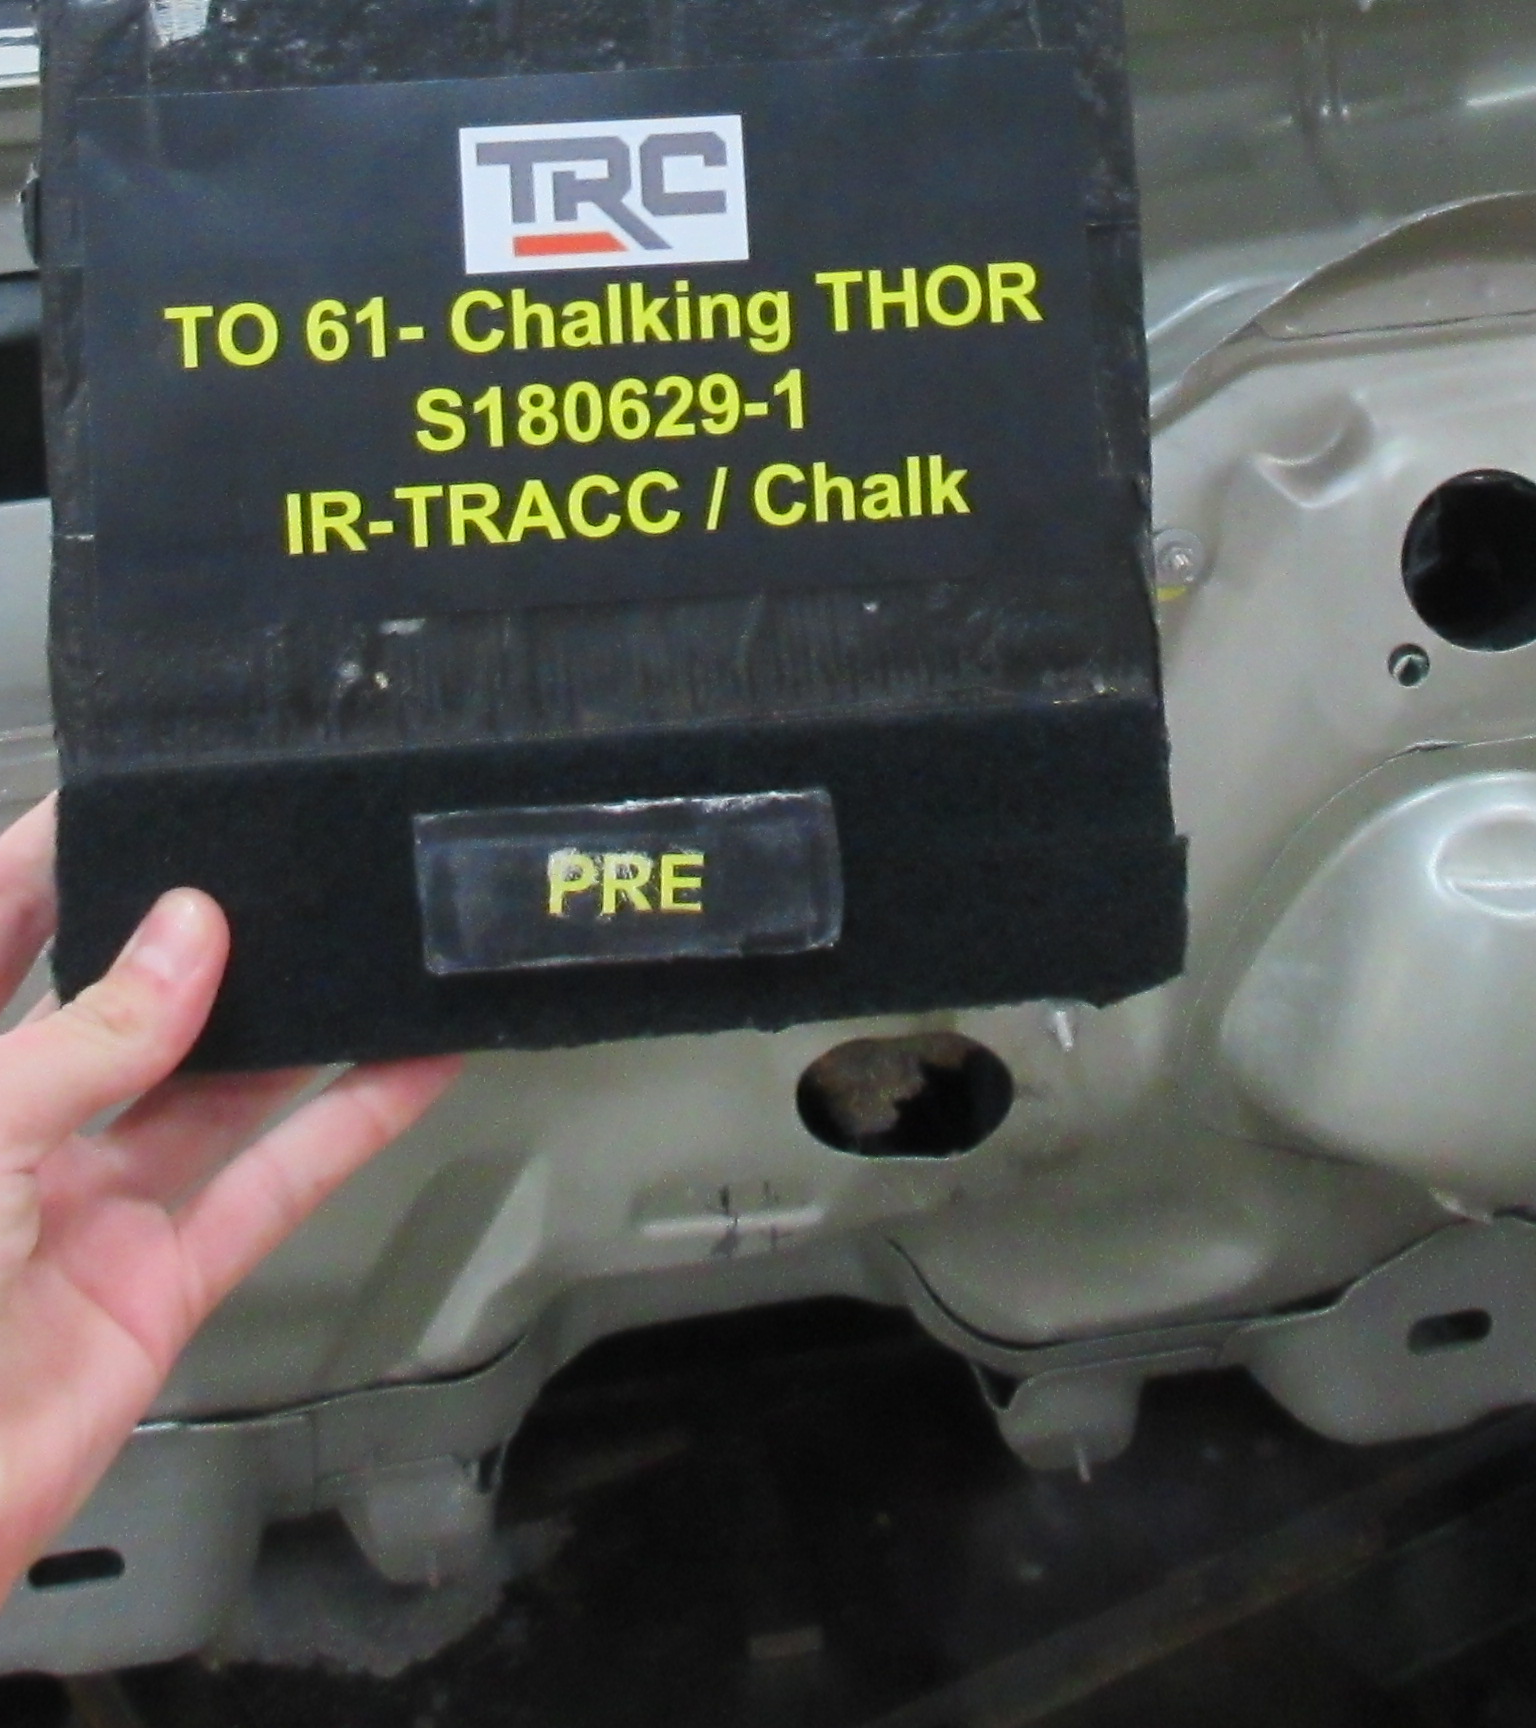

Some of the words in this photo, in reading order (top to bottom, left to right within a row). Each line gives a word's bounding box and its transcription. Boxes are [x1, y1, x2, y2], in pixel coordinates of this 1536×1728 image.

[476, 131, 728, 256] TRC
[164, 302, 279, 368] TO
[306, 298, 425, 362] 61-
[451, 282, 791, 354] Chalking
[814, 262, 1043, 332] THOR
[415, 371, 803, 451] S180629-1
[285, 471, 681, 556] IR-TRACC
[706, 467, 728, 528] /
[753, 457, 971, 527] Chalk
[548, 853, 705, 915] PRE
